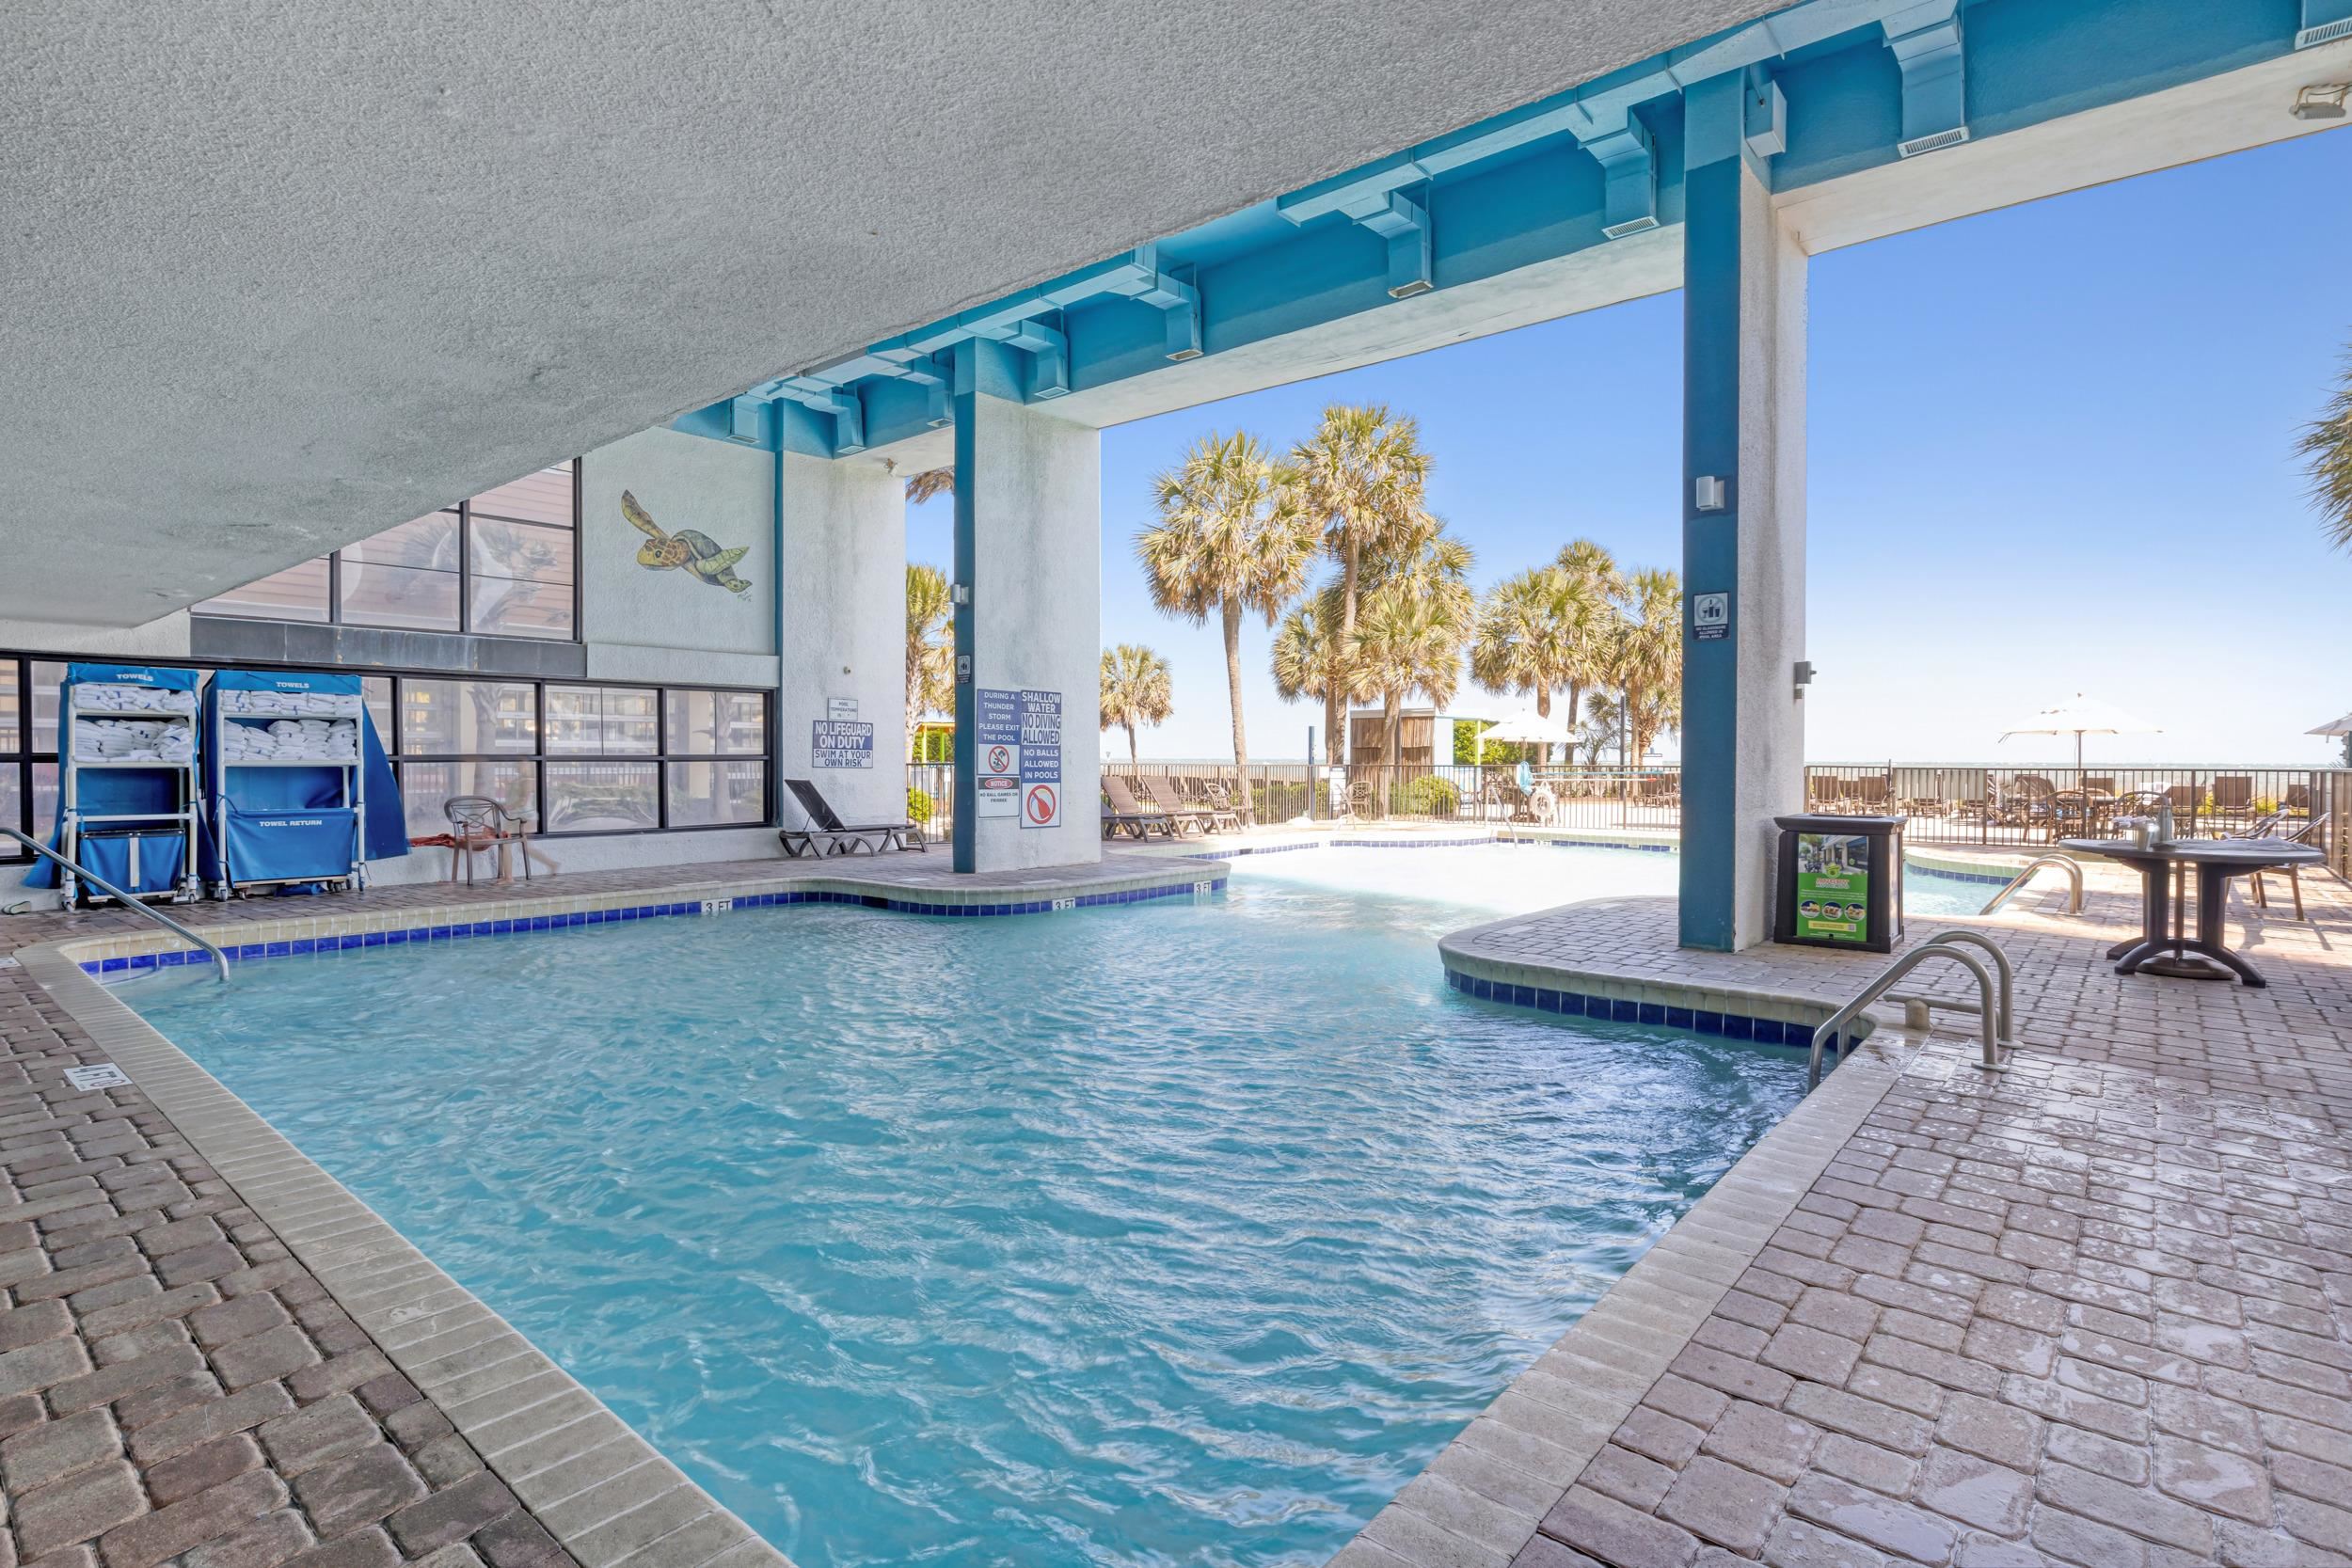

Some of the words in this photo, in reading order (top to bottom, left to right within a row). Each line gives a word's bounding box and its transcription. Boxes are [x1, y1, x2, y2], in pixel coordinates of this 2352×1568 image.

[117, 673, 153, 682] TOWELS
[1022, 692, 1061, 704] SHALLOW
[1028, 703, 1056, 713] WATER
[1022, 713, 1034, 729] NO
[1035, 714, 1061, 730] DIVING
[815, 722, 828, 734] NO
[829, 722, 872, 736] LIFEGUARD
[819, 735, 835, 748] ON
[837, 736, 865, 749] DUTY
[1023, 729, 1060, 744] ALLOWED
[815, 750, 836, 758] SWIM
[851, 751, 871, 759] YOUR
[1196, 884, 1201, 894] 3
[706, 903, 713, 912] 3
[718, 901, 731, 912] FT
[1056, 901, 1061, 910] 3
[1065, 899, 1074, 910] FT
